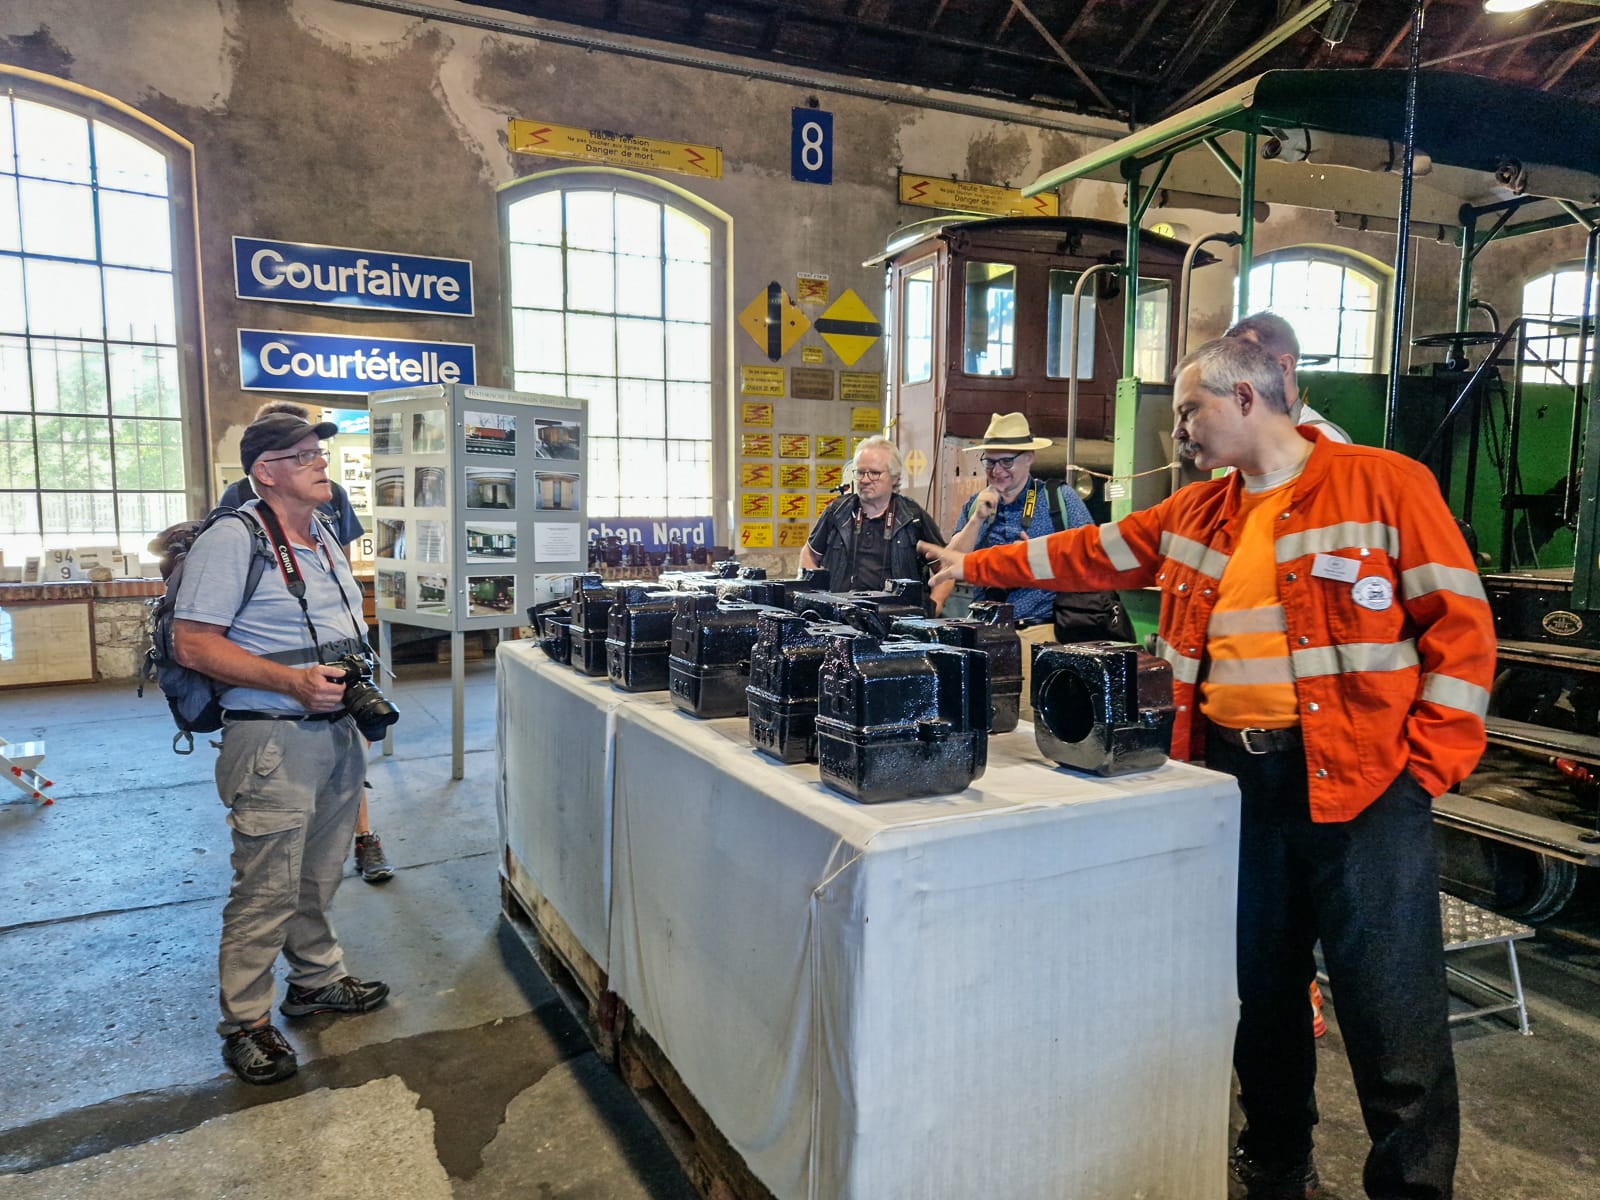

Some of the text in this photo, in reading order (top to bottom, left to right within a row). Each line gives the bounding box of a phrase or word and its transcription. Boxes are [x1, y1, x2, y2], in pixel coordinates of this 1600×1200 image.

[585, 143, 617, 156] Danger
[621, 149, 632, 158] de
[634, 152, 655, 161] mort
[801, 121, 824, 171] 8
[251, 248, 461, 302] Courfaivre
[260, 341, 461, 384] Courtételle
[652, 522, 705, 545] Nord
[279, 545, 295, 574] Canon
[362, 539, 374, 556] B
[60, 566, 72, 580] 9
